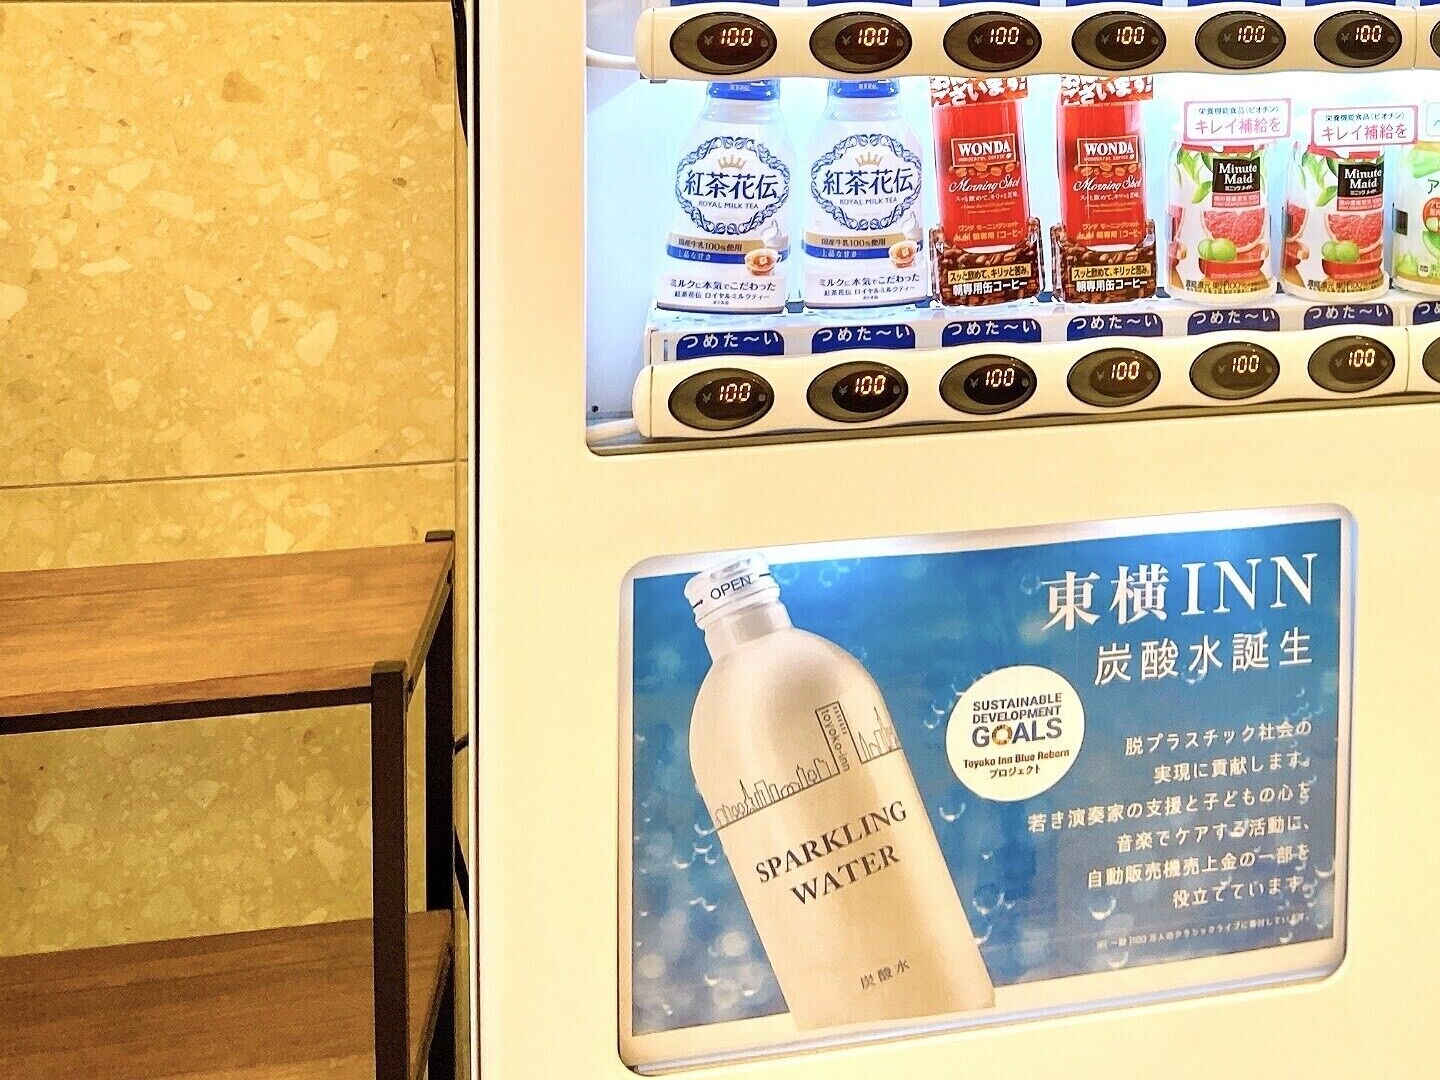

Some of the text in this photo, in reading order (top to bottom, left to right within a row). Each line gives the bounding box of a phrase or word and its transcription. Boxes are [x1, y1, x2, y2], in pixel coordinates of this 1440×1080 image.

[720, 27, 753, 46] 100
[857, 27, 889, 45] 100
[989, 27, 1020, 45] 100
[1116, 26, 1145, 44] 100
[1237, 25, 1266, 44] 100
[1355, 25, 1382, 43] 100
[1194, 118, 1281, 135] キレイ補給を
[1321, 125, 1407, 141] キレイ補給を
[958, 140, 1012, 156] WONDA
[1084, 141, 1135, 156] WONDA
[1218, 163, 1258, 175] Minute
[1344, 168, 1382, 180] Minute
[684, 172, 779, 200] 紅茶花伝
[822, 168, 913, 196] 紅茶花伝
[949, 174, 1021, 192] Morning Shot
[1224, 174, 1254, 185] Maid
[1349, 178, 1378, 190] Maid
[699, 200, 723, 209] ROYAL
[724, 201, 744, 209] MILK
[670, 278, 776, 293] ミルクに本気でこだわった
[818, 273, 920, 287] ミルクに本気でこだわった
[952, 280, 1028, 296] 朝専用缶コーヒー
[1076, 279, 1148, 292] 朝専用缶コーヒー
[1231, 354, 1260, 373] 100
[1349, 349, 1376, 368] 100
[985, 368, 1015, 387] 100
[1111, 361, 1140, 380] 100
[719, 383, 751, 403] 100
[854, 376, 885, 395] 100
[709, 574, 753, 601] OPEN
[1042, 552, 1319, 633] 東横INN
[1094, 629, 1314, 688] 炭酸水誕生
[973, 692, 1063, 712] SUSTAINABLE
[973, 705, 1062, 724] DEVELOPMENT
[972, 717, 1062, 748] GOALS
[1125, 716, 1312, 757] 脱プラスチック社会の
[990, 764, 1041, 779] プロジェクト
[1153, 750, 1311, 785] 実現に貢献します。
[1027, 781, 1311, 834] 若き演奏家の支援と子どもの心を
[755, 800, 909, 885] SPARKLING
[1116, 815, 1311, 853] 音楽でケアする活動に、
[789, 844, 901, 906] WATER
[1087, 842, 1310, 889] 自動販売機売上金の一部を
[859, 957, 911, 991] 炭酸水
